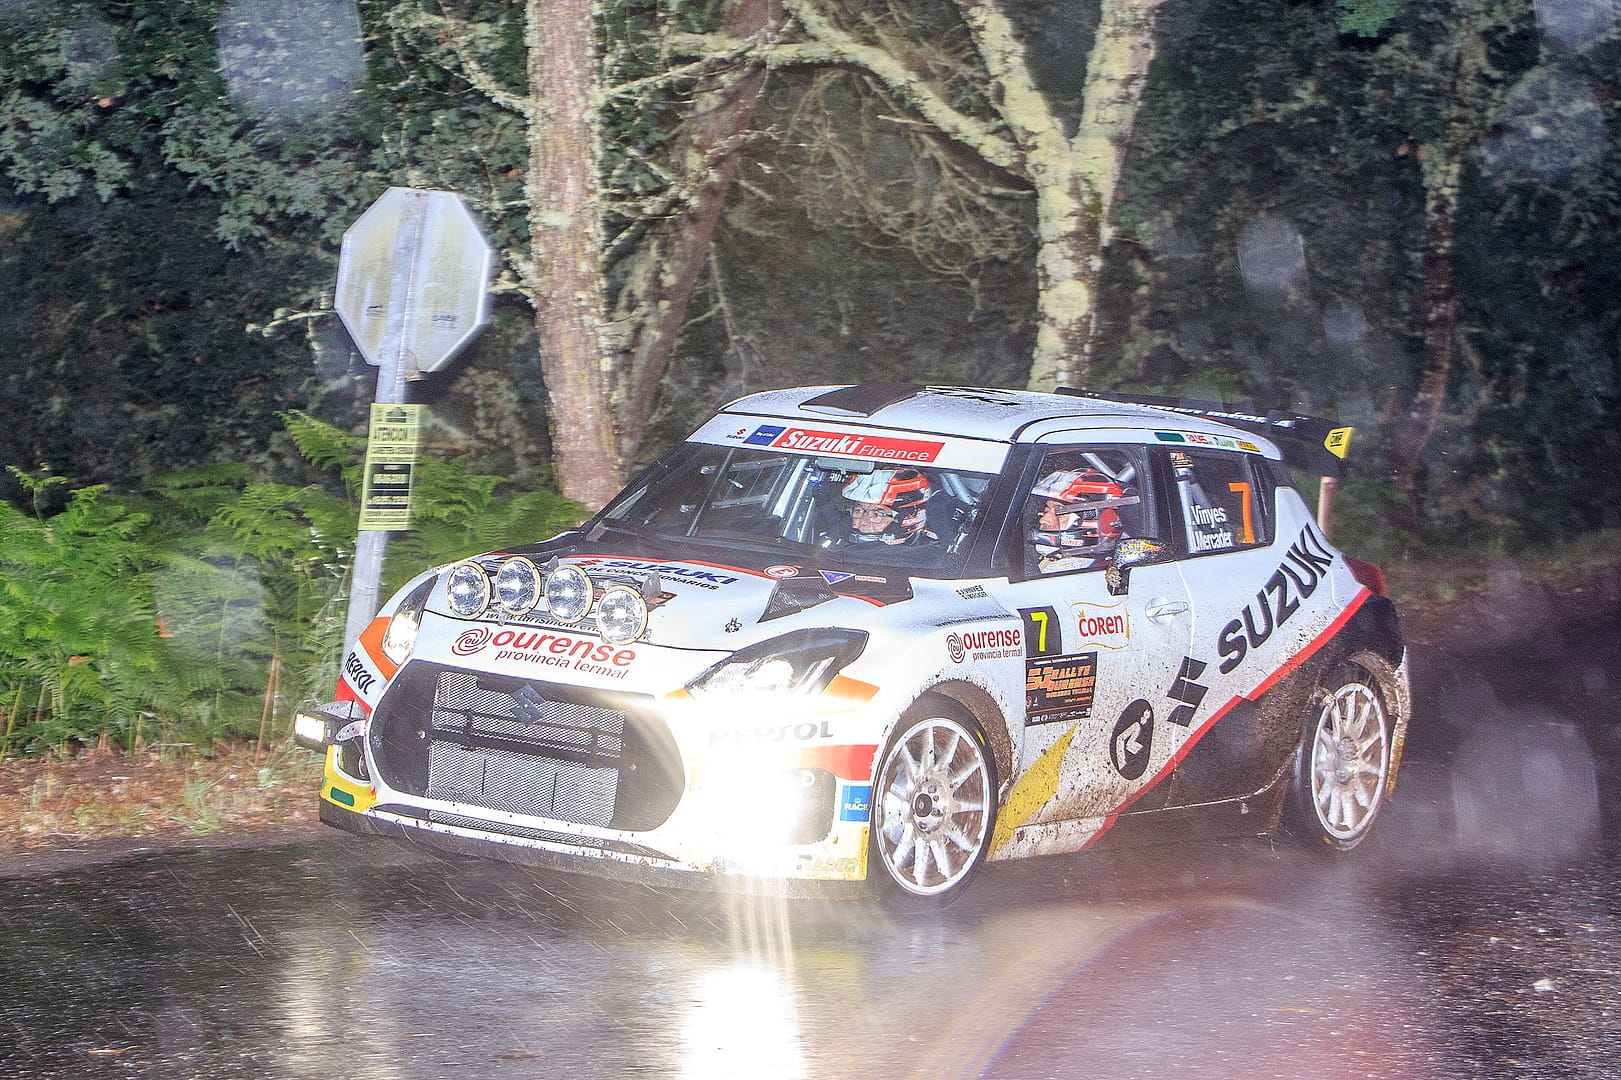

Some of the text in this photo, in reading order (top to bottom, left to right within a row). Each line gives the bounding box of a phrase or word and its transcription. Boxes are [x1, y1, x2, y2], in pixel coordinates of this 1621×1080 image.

[781, 430, 930, 461] Suzuki Finance
[1228, 482, 1255, 544] 7
[604, 561, 739, 585] SUZUKI
[1217, 522, 1334, 675] SUZUKI
[963, 629, 1021, 650] ourense
[1030, 611, 1048, 652] 7
[492, 630, 636, 667] ourense
[972, 646, 1022, 662] provincia termal
[345, 652, 376, 695] REPSOL
[495, 650, 629, 680] provincia termal
[708, 720, 834, 749] REPSOL
[844, 803, 868, 811] RACE
